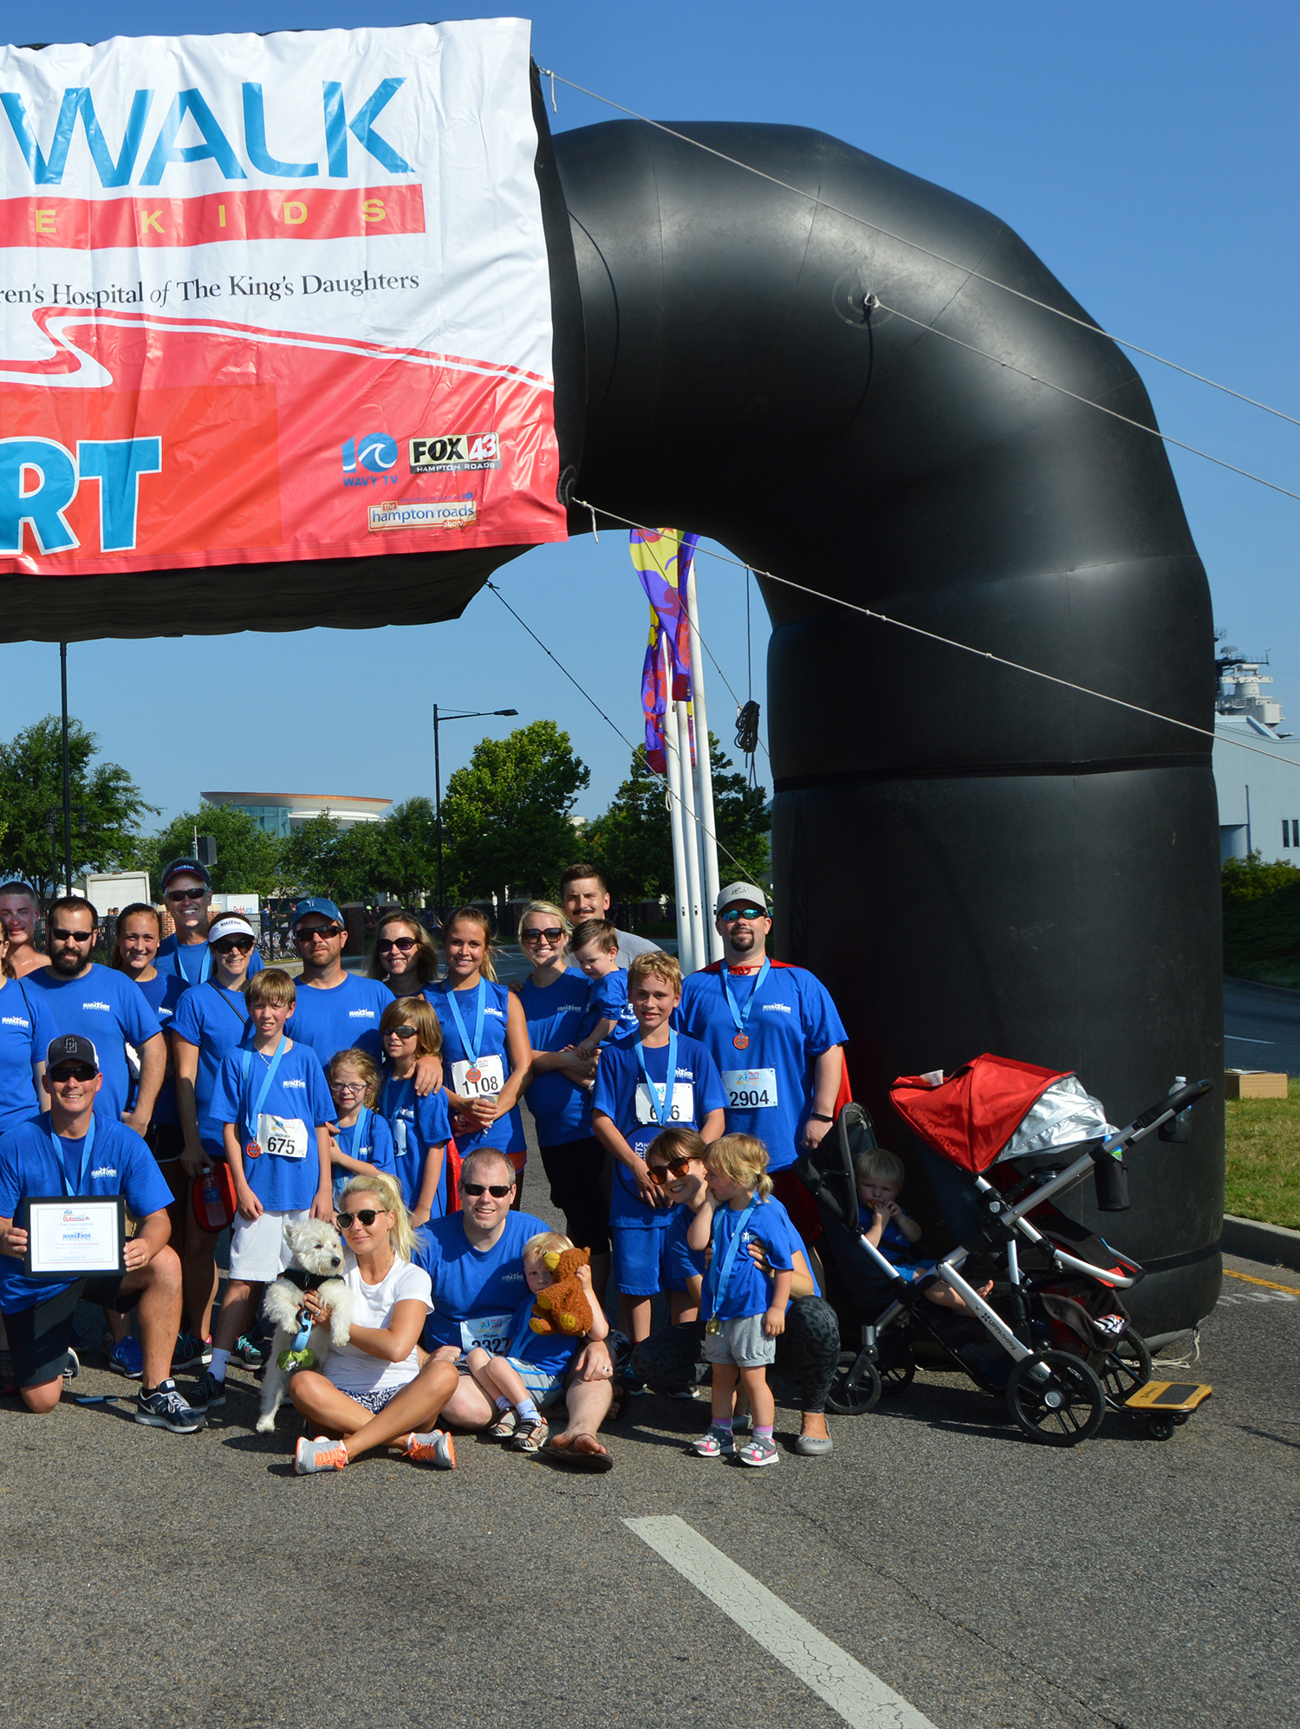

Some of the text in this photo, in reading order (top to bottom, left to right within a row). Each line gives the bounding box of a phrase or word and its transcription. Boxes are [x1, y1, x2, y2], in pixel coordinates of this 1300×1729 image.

[141, 198, 387, 234] KIDS
[52, 281, 144, 309] Hospital
[150, 280, 173, 307] of
[176, 278, 222, 301] The
[228, 275, 294, 301] King's
[301, 270, 420, 296] Daughters
[412, 433, 498, 463] FOX 43
[416, 462, 496, 473] HAMPTON ROADS
[343, 475, 399, 488] WAVY TV
[372, 505, 474, 525] hampton roads
[729, 1088, 770, 1107] 2904
[267, 1135, 295, 1155] 675
